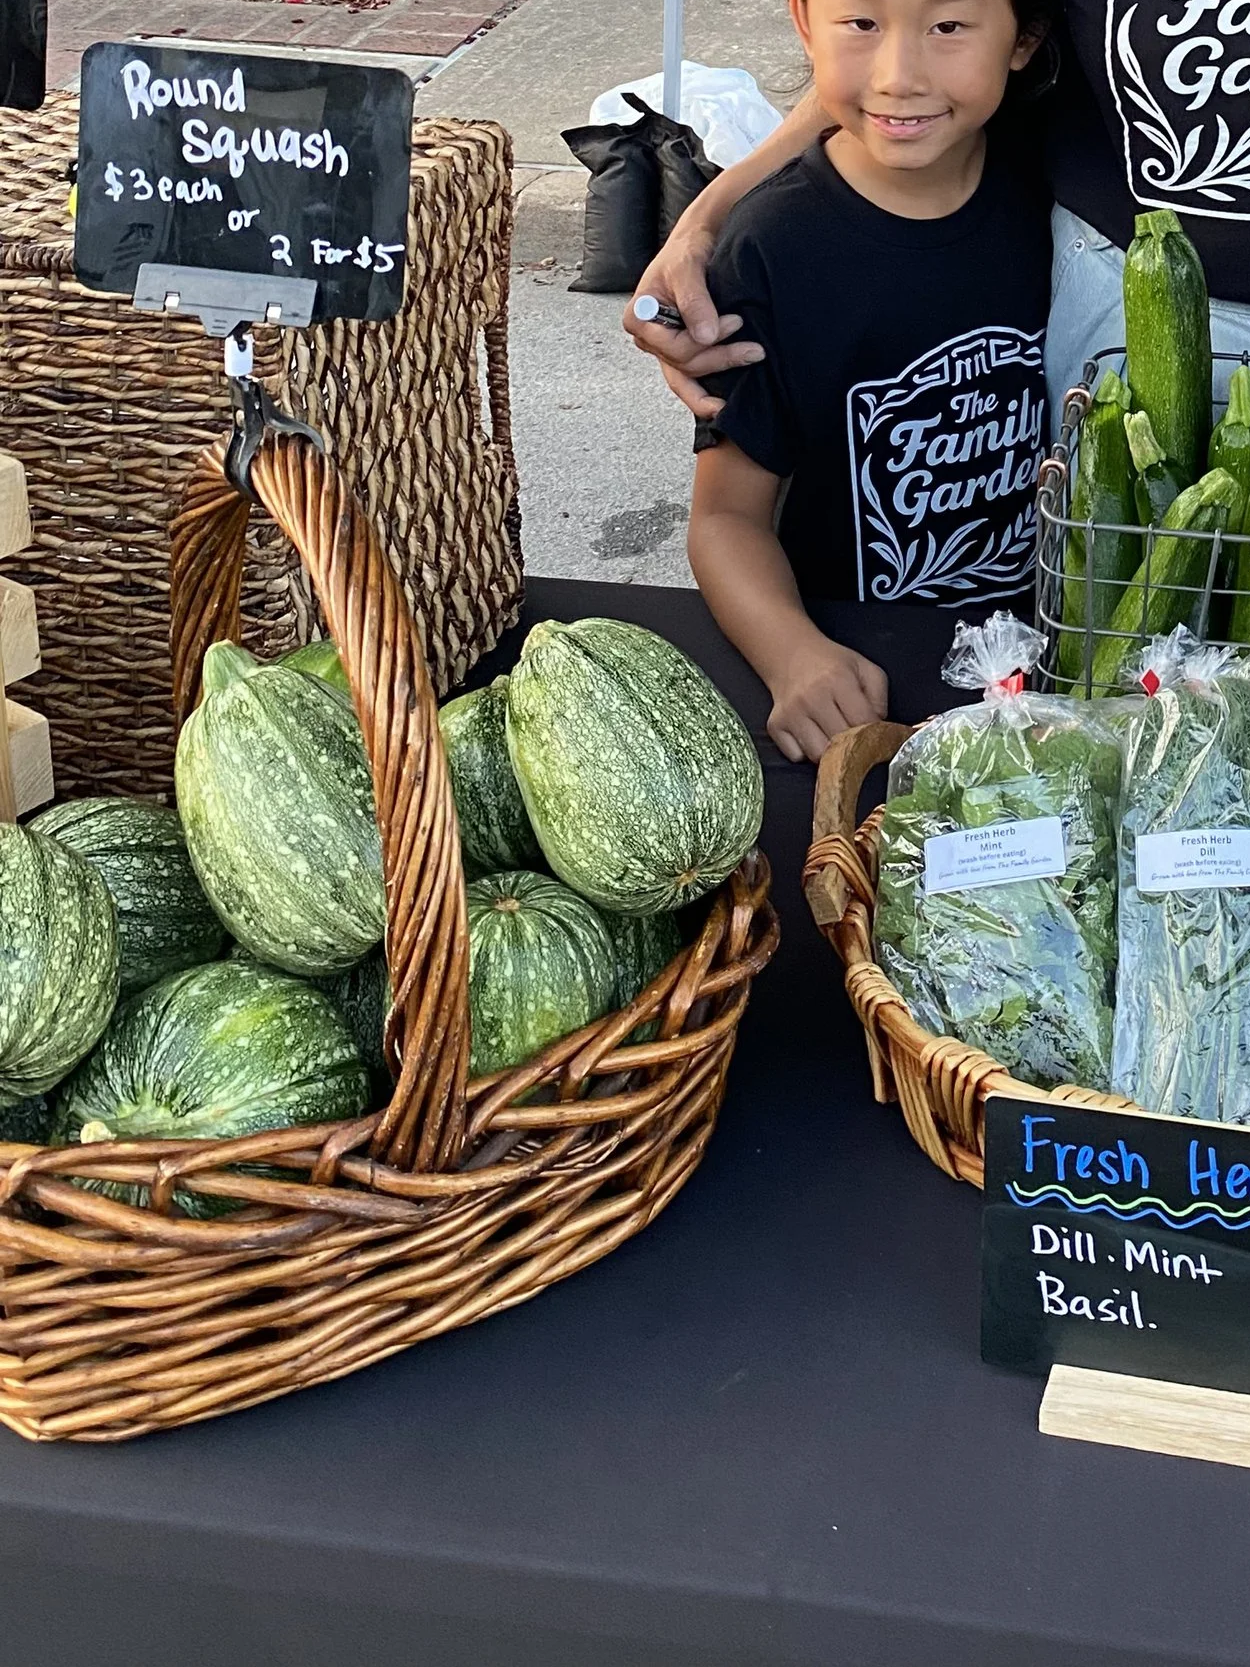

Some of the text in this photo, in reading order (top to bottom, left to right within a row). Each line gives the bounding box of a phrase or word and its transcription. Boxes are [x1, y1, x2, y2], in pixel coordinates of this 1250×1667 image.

[120, 59, 247, 120] Round
[181, 118, 350, 178] Squash
[226, 207, 261, 232] or
[268, 233, 294, 267] 2
[950, 389, 999, 424] The
[886, 387, 1045, 473] Family
[964, 826, 1016, 843] Fresh Herb
[980, 841, 1003, 852] Mint
[1181, 834, 1232, 846] Fresh Herb
[1199, 846, 1217, 857] Dill
[1021, 1114, 1150, 1190] Fresh
[1123, 1238, 1223, 1285] Mint
[1036, 1269, 1158, 1330] Basil.
